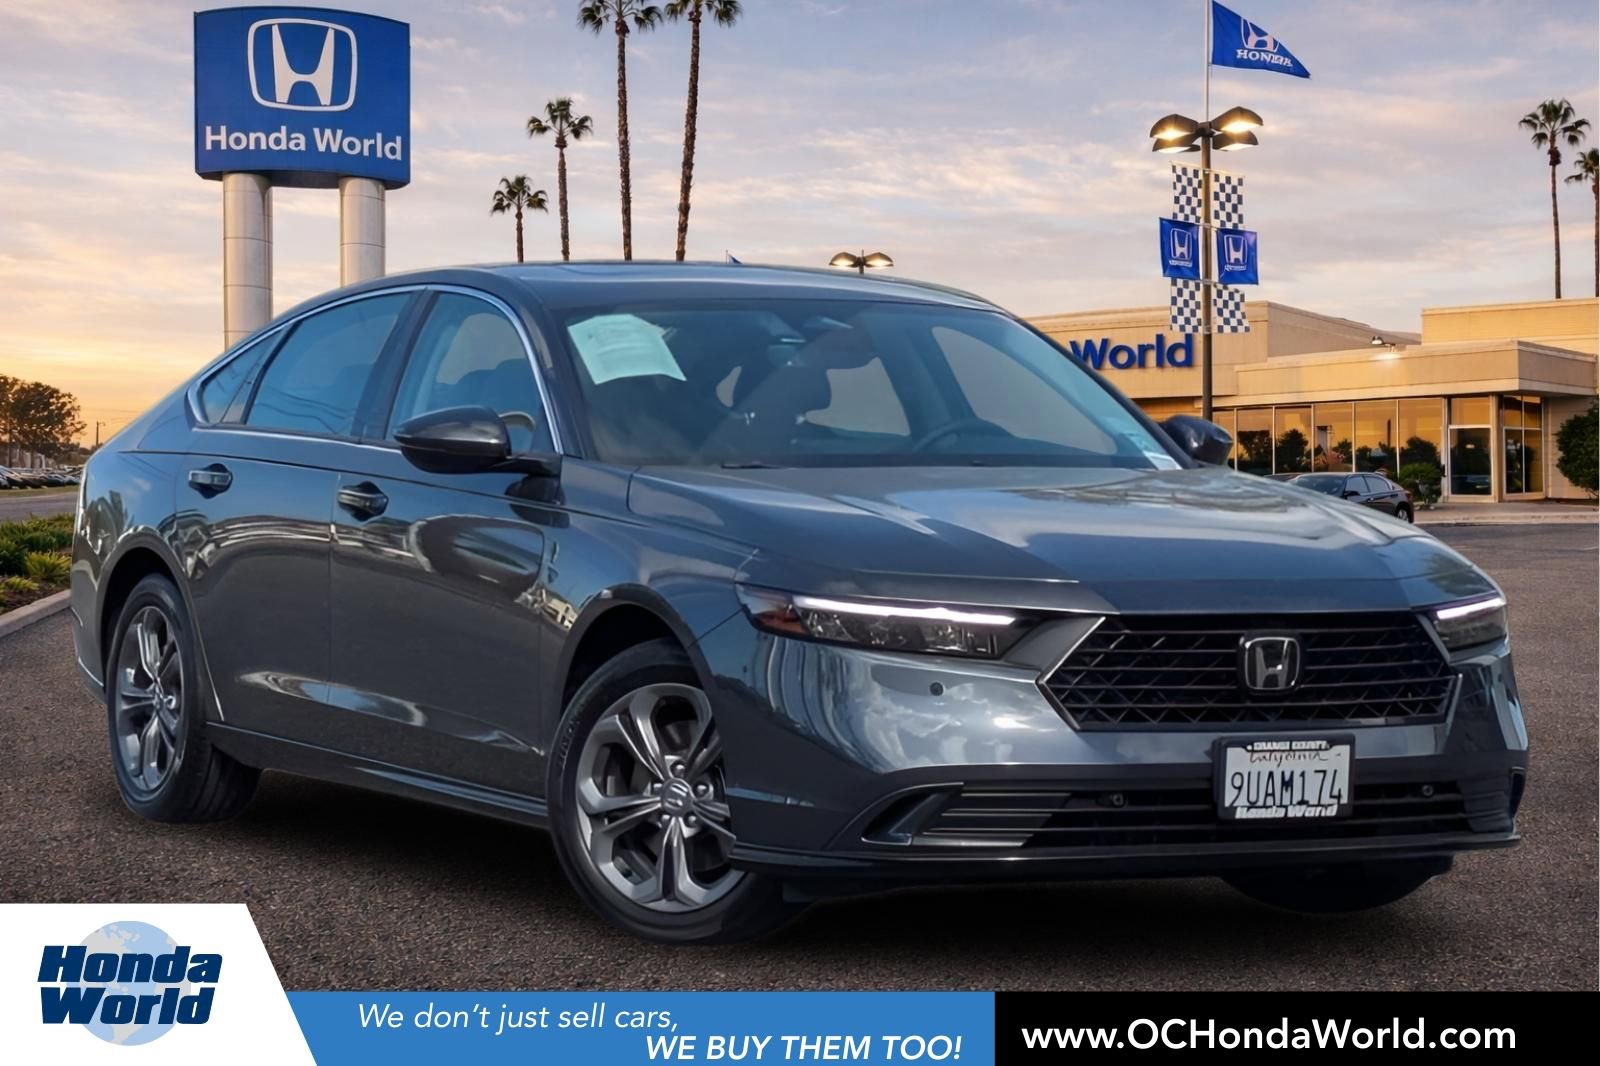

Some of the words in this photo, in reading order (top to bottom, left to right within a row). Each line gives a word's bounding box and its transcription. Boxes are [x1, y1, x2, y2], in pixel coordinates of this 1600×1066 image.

[1236, 49, 1293, 67] HONDA
[205, 125, 306, 151] Honda
[313, 127, 402, 161] World
[1069, 333, 1193, 370] World
[1229, 769, 1342, 807] 9UAM174
